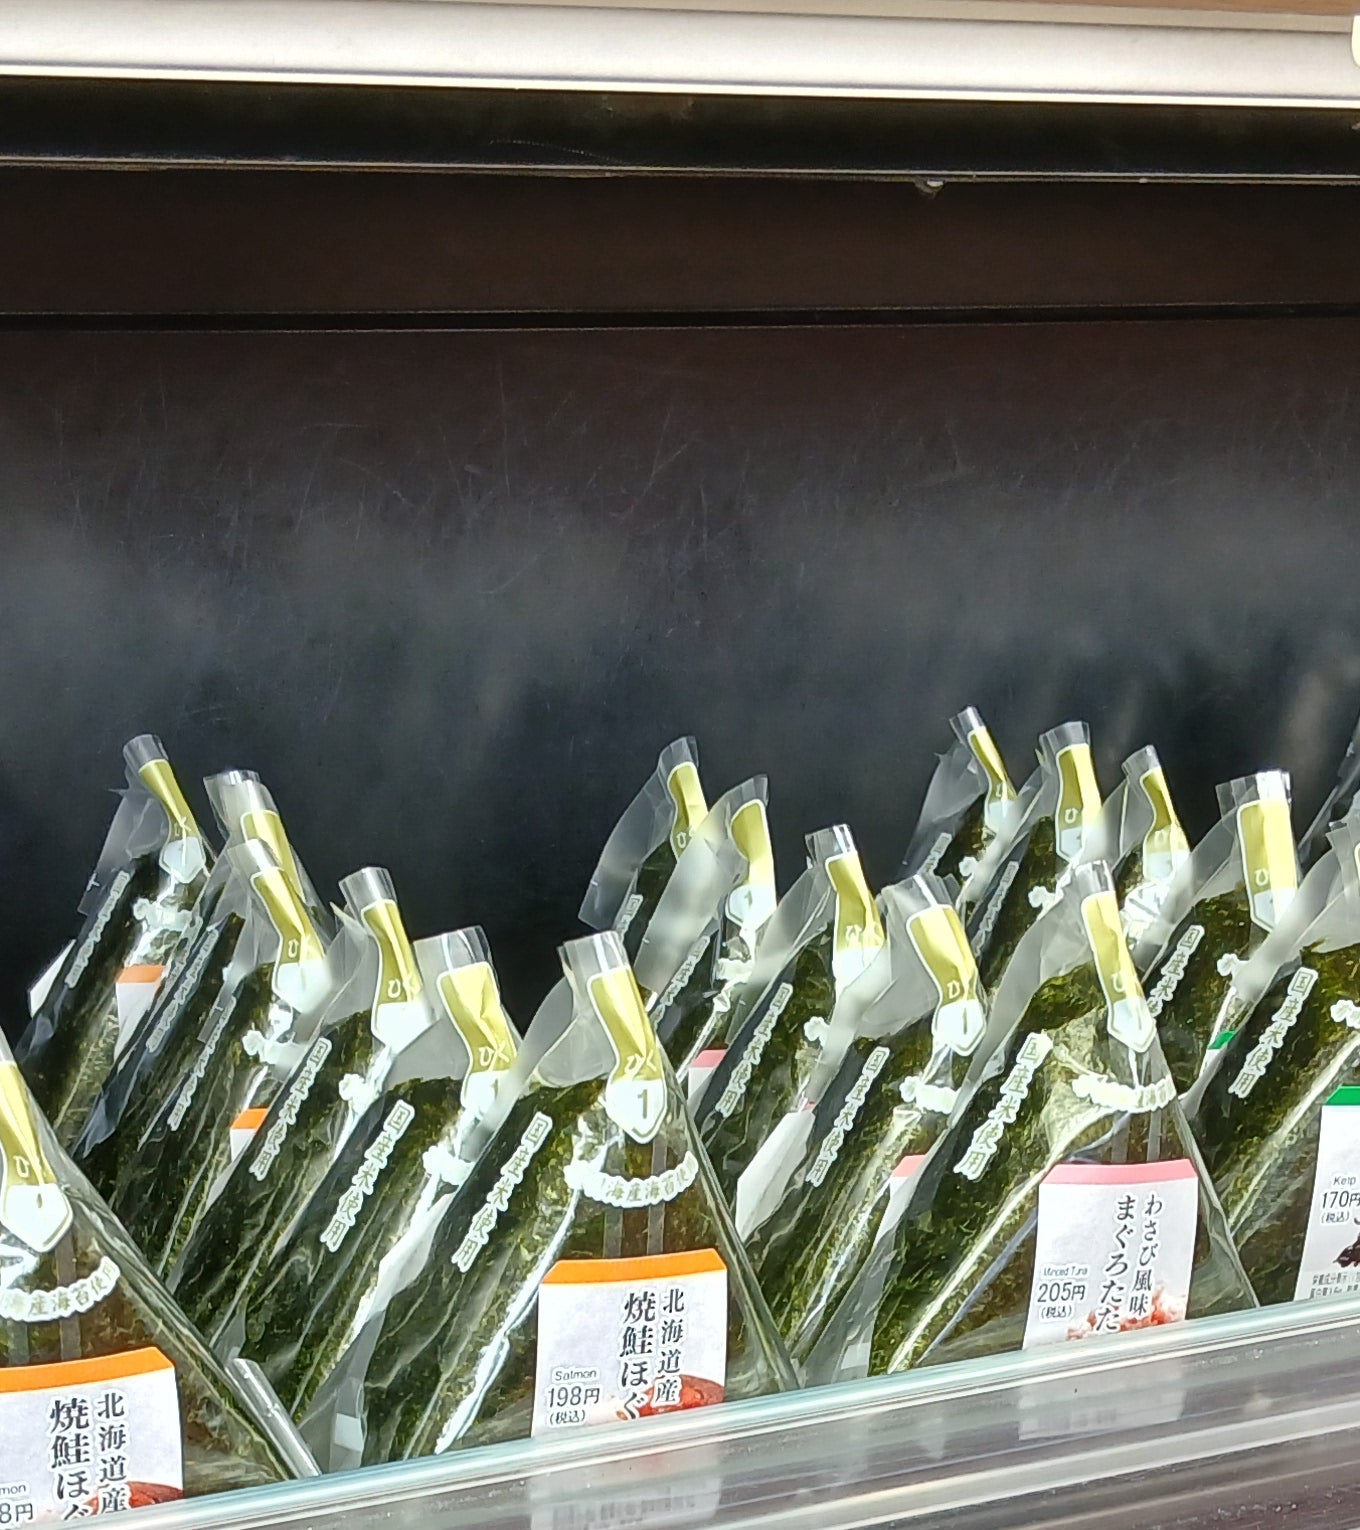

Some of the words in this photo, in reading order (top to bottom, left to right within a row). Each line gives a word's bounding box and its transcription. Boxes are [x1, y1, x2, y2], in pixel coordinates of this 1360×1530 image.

[953, 1033, 1050, 1180] 国産米使用
[1036, 1281, 1087, 1303] 205円
[1096, 1194, 1137, 1332] まぐろたた
[1129, 1193, 1163, 1317] わさび風味
[547, 1385, 601, 1409] 198円
[554, 1369, 597, 1382] Salmon
[618, 1290, 657, 1421] 焼鮭ほぐ
[654, 1287, 686, 1405] 北海道産
[97, 1392, 130, 1516] 北海道産
